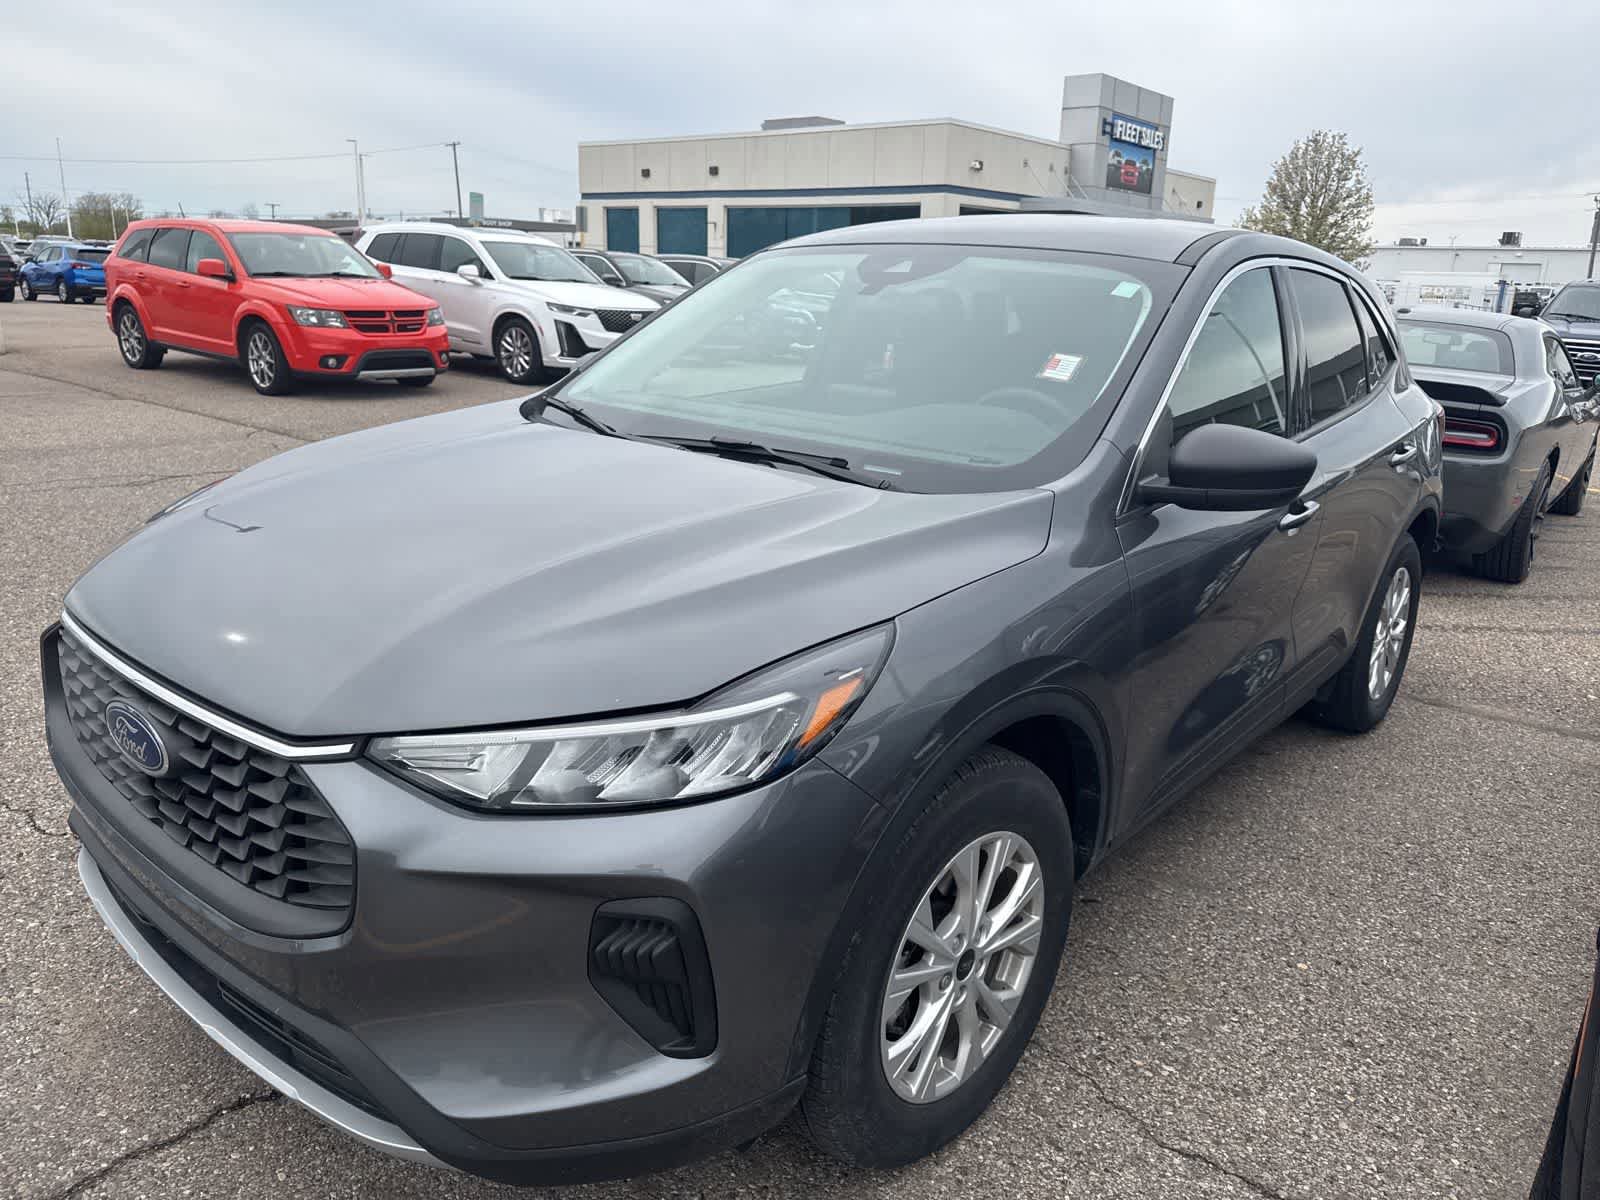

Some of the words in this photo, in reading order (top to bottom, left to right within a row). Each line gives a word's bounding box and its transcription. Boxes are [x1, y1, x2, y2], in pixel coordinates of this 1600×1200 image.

[1116, 119, 1140, 144] FLEET
[1141, 126, 1164, 150] SALES
[113, 715, 148, 763] Ford
